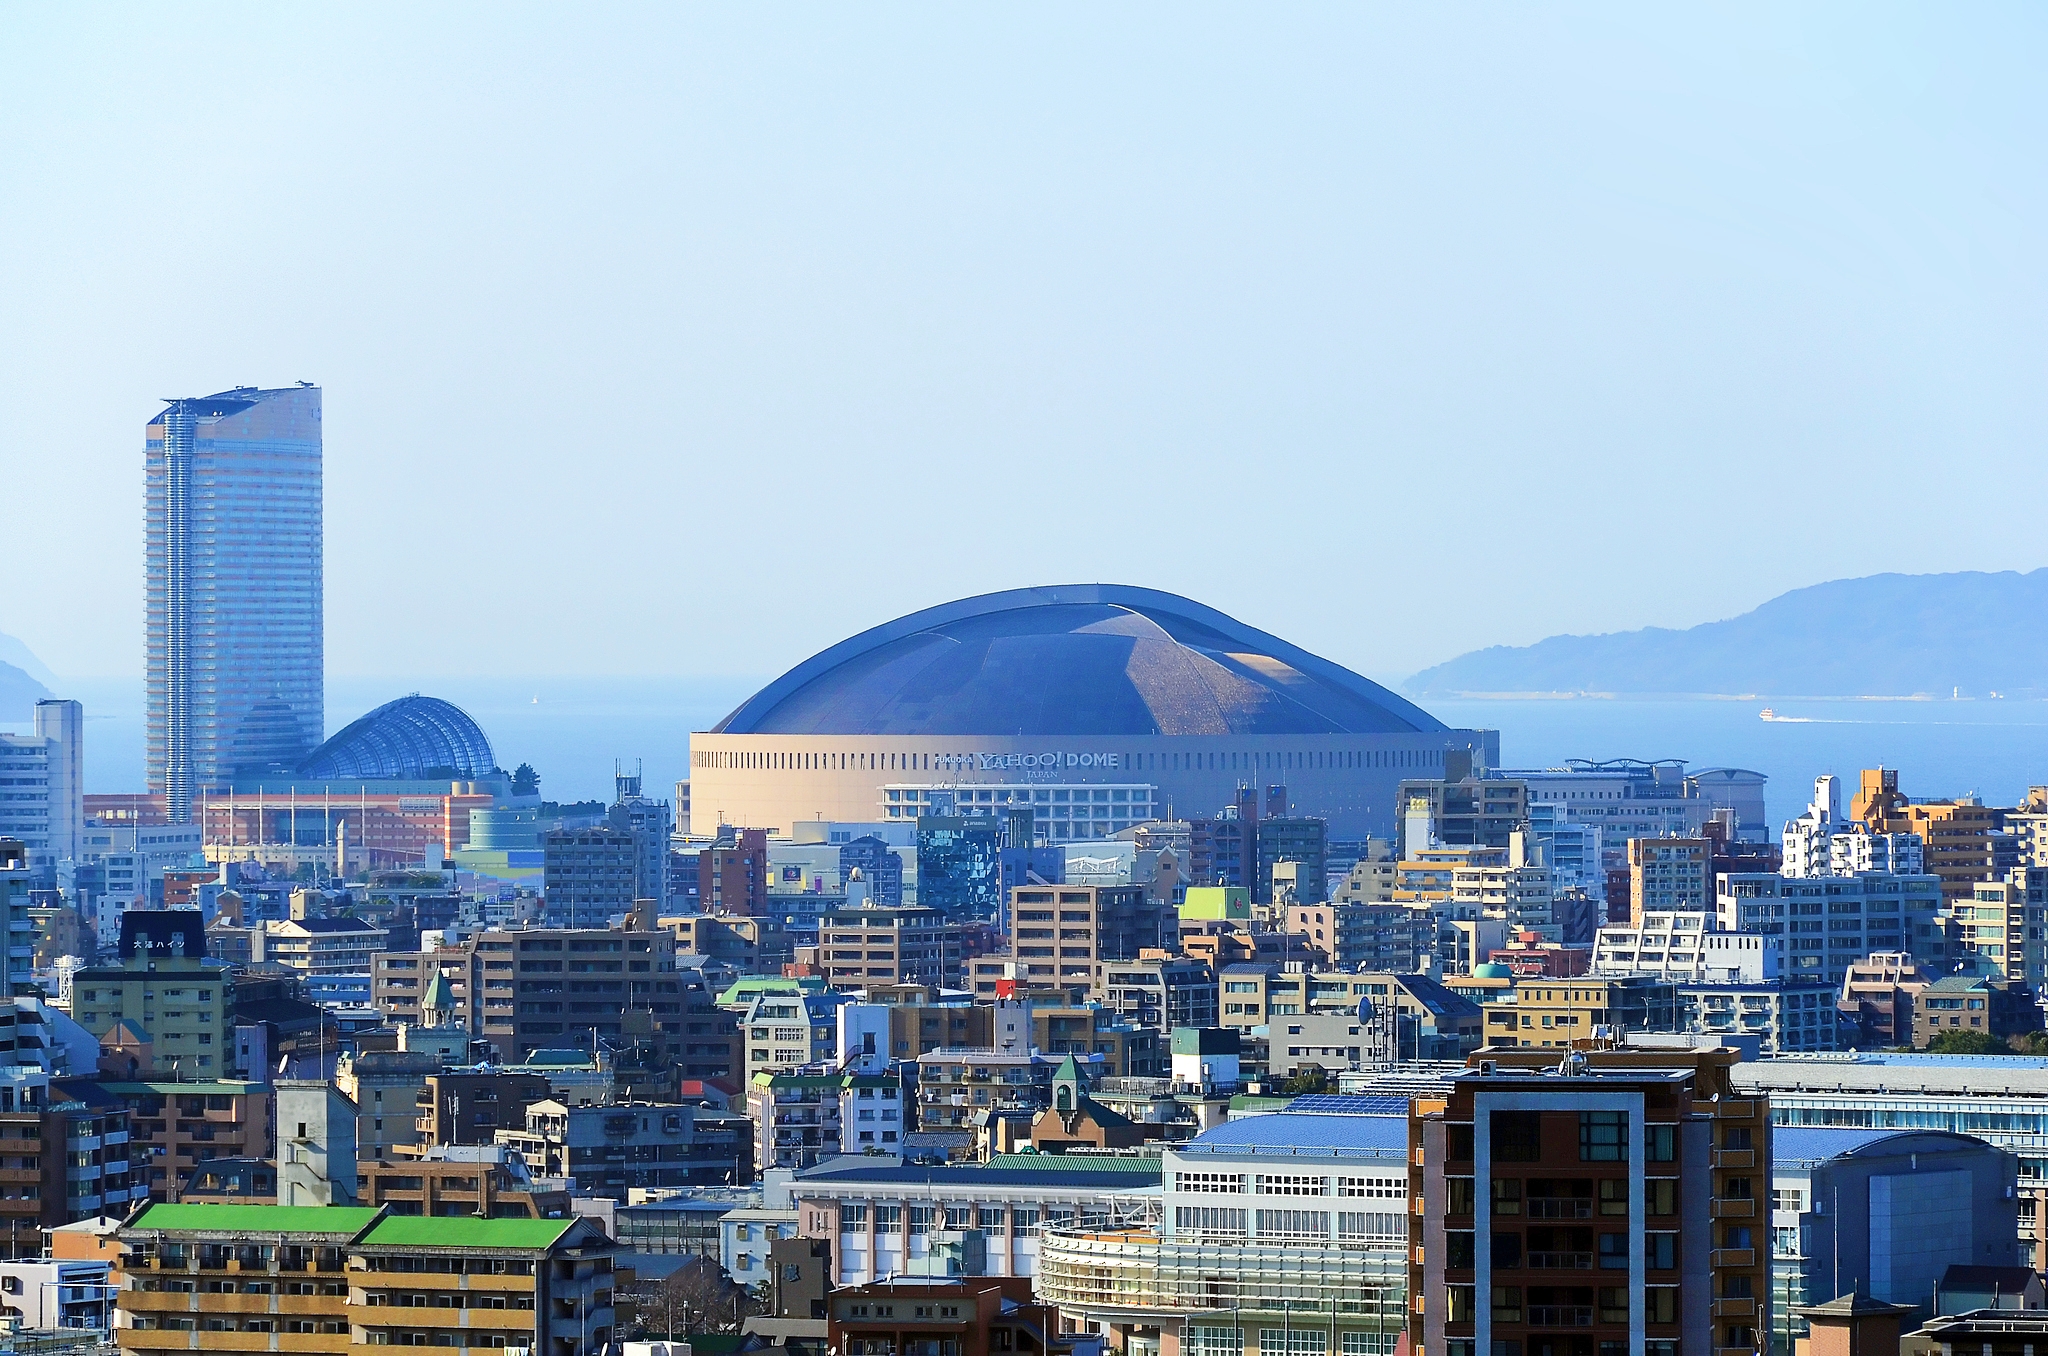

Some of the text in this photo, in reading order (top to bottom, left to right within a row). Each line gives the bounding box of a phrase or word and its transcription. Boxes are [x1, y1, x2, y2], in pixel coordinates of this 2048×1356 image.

[935, 751, 1118, 770] FUKUOKA YAHOO! DOME
[1026, 770, 1058, 779] JAPAN
